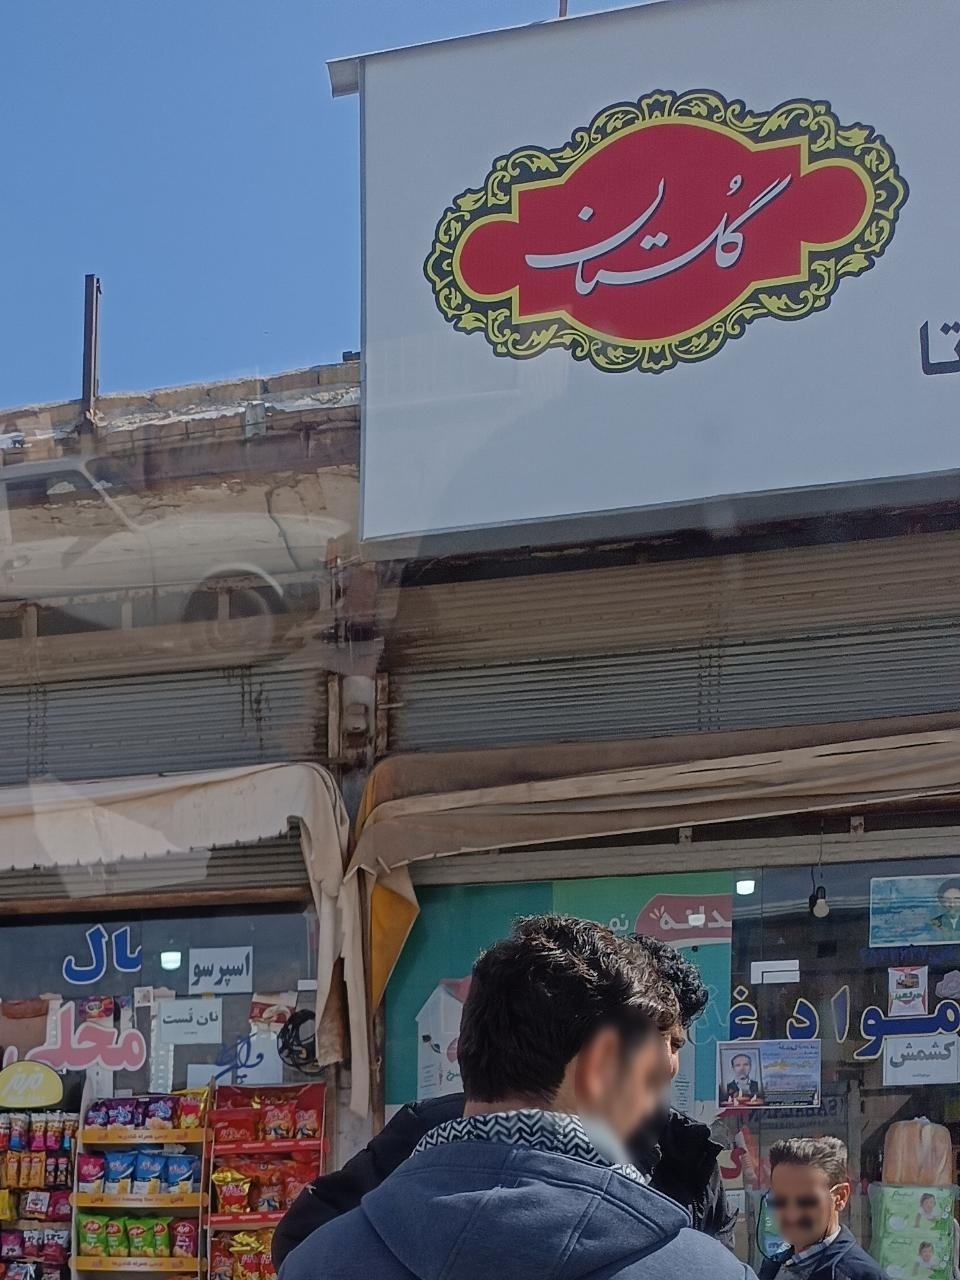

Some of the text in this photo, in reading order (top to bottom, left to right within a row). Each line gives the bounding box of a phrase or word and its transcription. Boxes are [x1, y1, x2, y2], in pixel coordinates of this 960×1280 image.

[191, 952, 251, 986] اسپرسو
[196, 1011, 219, 1026] نان
[787, 985, 960, 1060] مواد
[889, 1040, 956, 1068] کشمش
